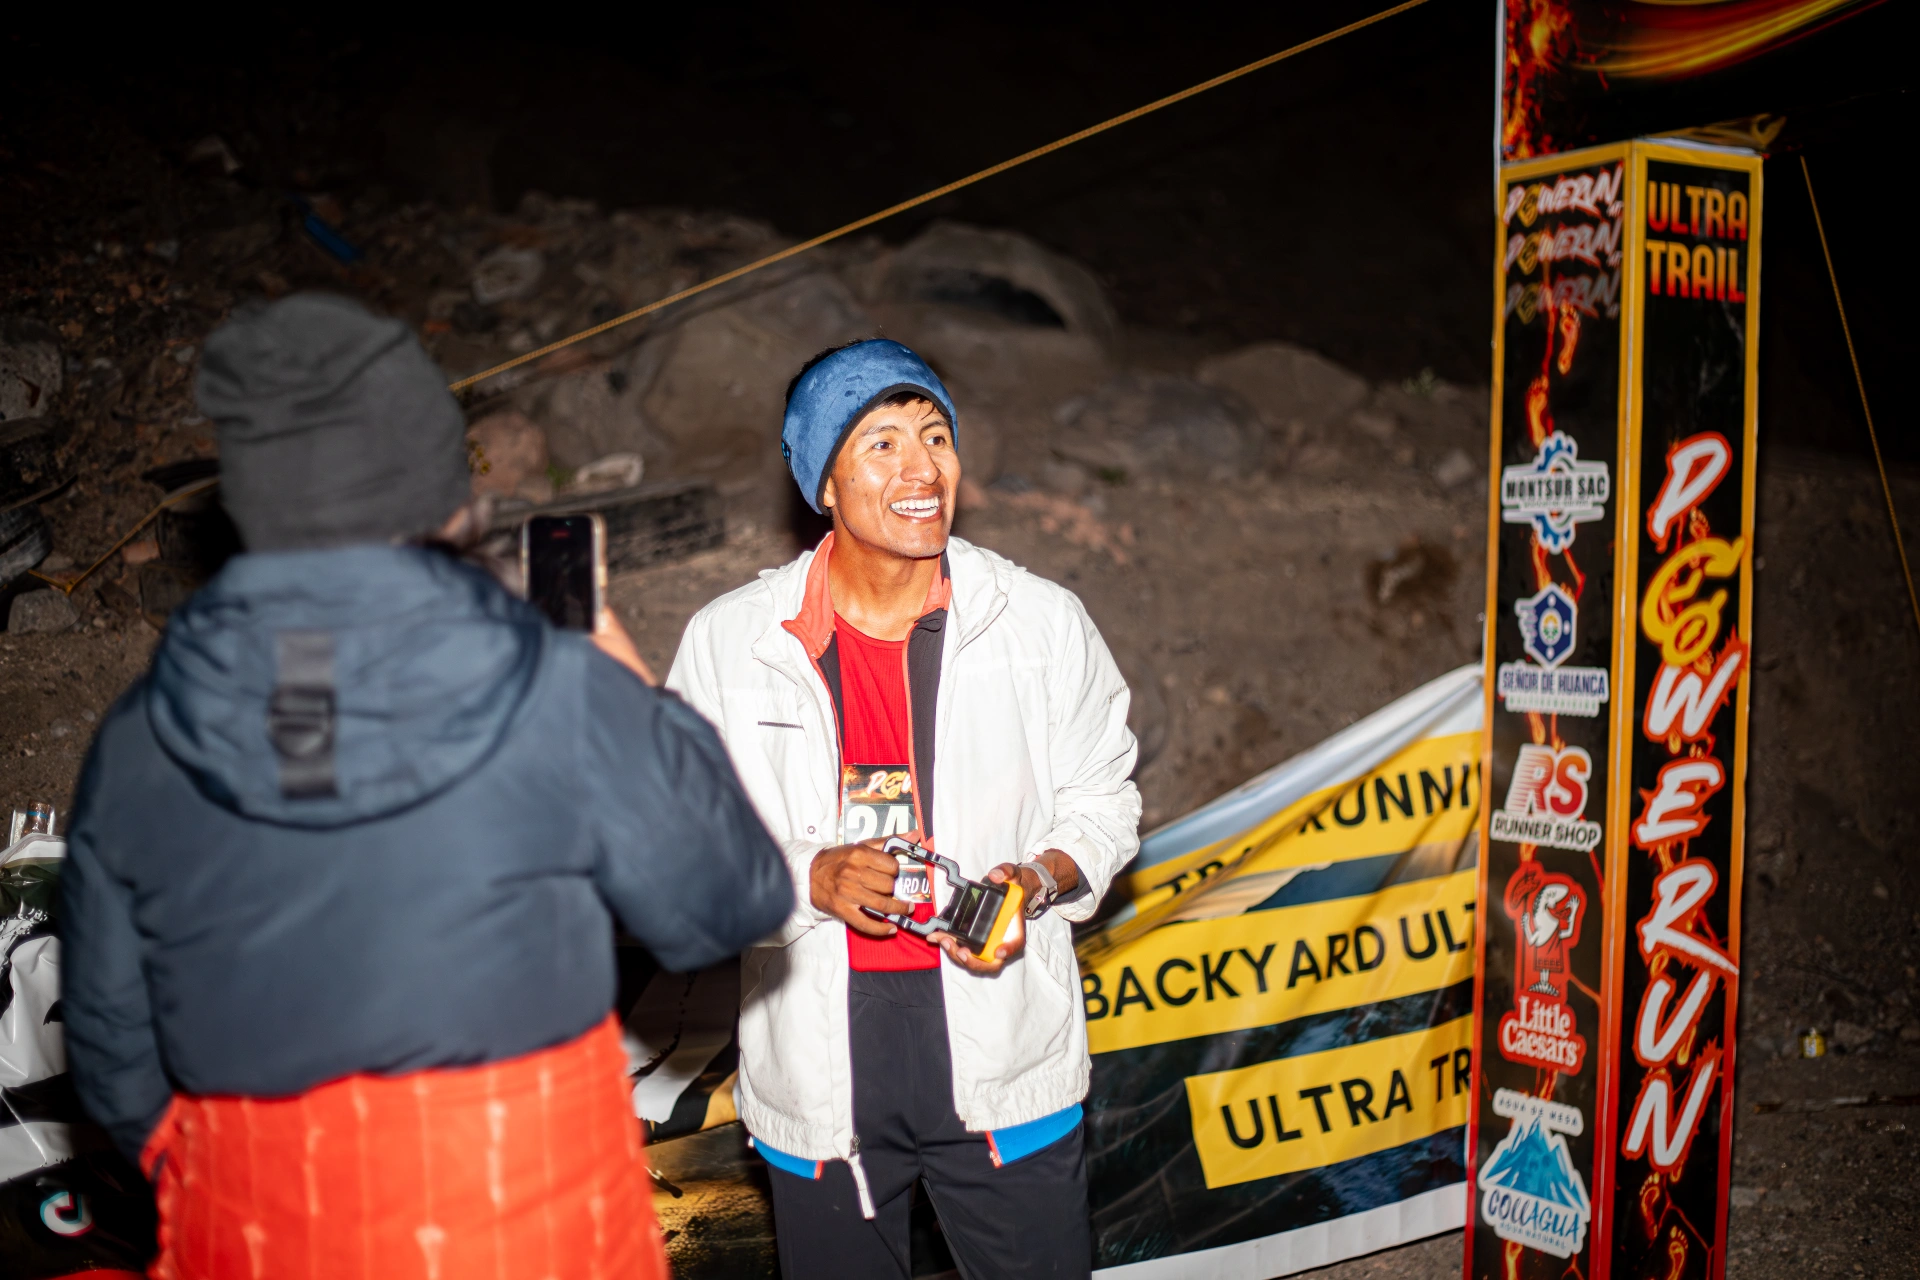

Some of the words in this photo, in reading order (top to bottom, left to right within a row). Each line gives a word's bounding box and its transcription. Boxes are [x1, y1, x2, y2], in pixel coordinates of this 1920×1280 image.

[1648, 180, 1748, 241] ULTRA
[1646, 239, 1746, 303] TRAIL
[1506, 478, 1573, 499] MONTSUR
[1577, 476, 1606, 496] SAC
[1541, 672, 1554, 692] DE
[1557, 674, 1606, 696] HUANCA
[1505, 752, 1587, 815] RS
[1494, 817, 1553, 839] RUNNER
[1555, 822, 1598, 846] SHOP
[1082, 925, 1386, 1021] BACKYARD
[1518, 995, 1571, 1039] Little
[1502, 1018, 1578, 1068] Caesars
[1221, 1067, 1414, 1149] ULTRA
[1499, 1096, 1527, 1113] AGUA
[1530, 1104, 1545, 1117] DE
[1549, 1110, 1579, 1128] MESA
